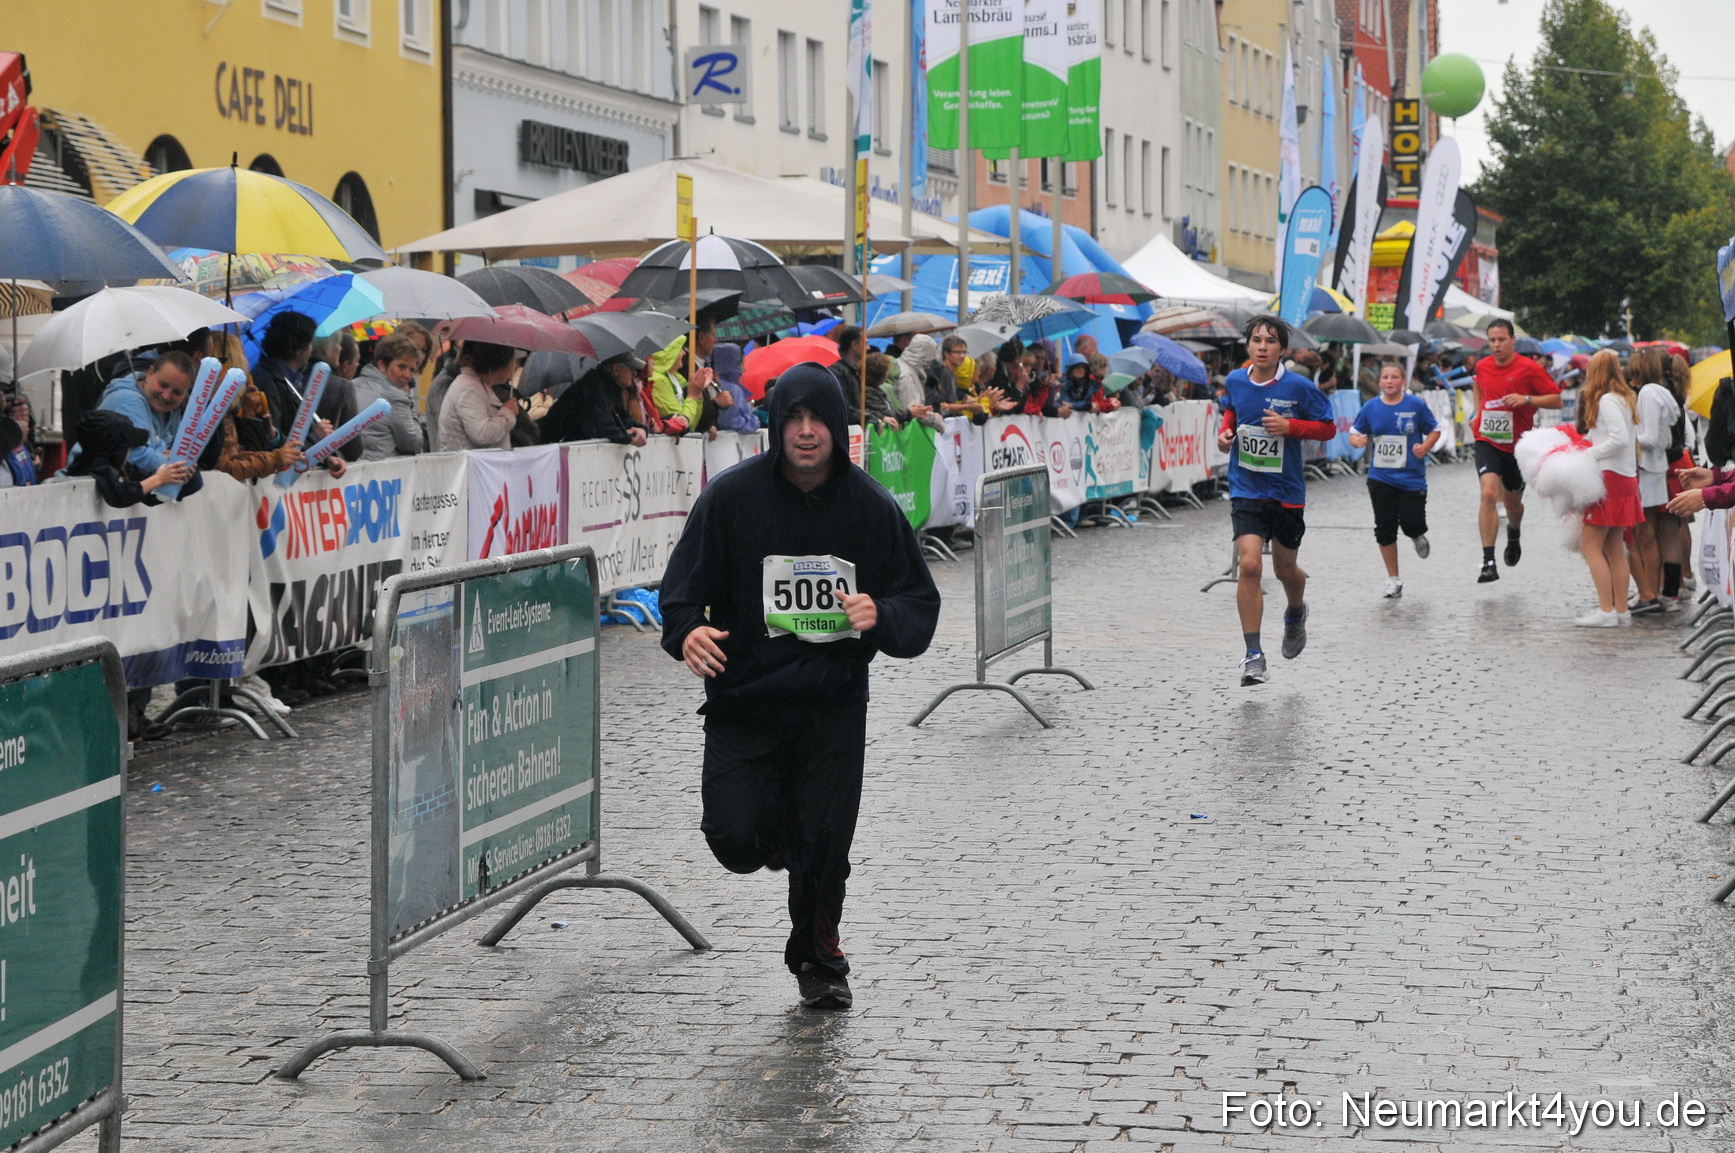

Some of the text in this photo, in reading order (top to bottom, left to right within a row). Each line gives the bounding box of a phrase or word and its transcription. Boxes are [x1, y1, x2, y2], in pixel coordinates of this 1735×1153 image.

[945, 0, 1002, 8] Nemarkter
[692, 52, 741, 96] R.
[216, 61, 314, 137] CAFE DELI
[528, 120, 630, 177] BRILLEN WEBER
[1393, 101, 1420, 199] HOT
[956, 266, 1006, 286] axi
[177, 367, 217, 458] TUI ReiseCenter
[196, 379, 239, 443] ReiseCenter
[295, 369, 325, 433] ReiseCenter
[313, 410, 385, 461] TUI ReiseCenter
[1242, 435, 1279, 456] 5024
[1483, 419, 1509, 431] 5022
[1377, 443, 1403, 456] 4024
[411, 492, 458, 515] Kastengasse
[582, 478, 622, 508] RECHTS
[645, 466, 693, 498] ANWÄLTE
[283, 478, 401, 560] INTERSPORT
[411, 532, 420, 551] Im
[0, 516, 153, 641] BOCK
[793, 561, 831, 570] BOCK
[487, 601, 551, 634] Event-Leit-Systeme
[774, 577, 850, 611] 5089
[792, 618, 836, 631] Tristan
[467, 679, 553, 746] Fun & Action in
[467, 735, 561, 811] sicheren Bahnen!
[485, 849, 493, 876] &
[493, 840, 518, 874] Service
[518, 833, 535, 860] Line:
[535, 821, 555, 852] 09181
[555, 813, 572, 843] 6352
[38, 1056, 69, 1107] 6352
